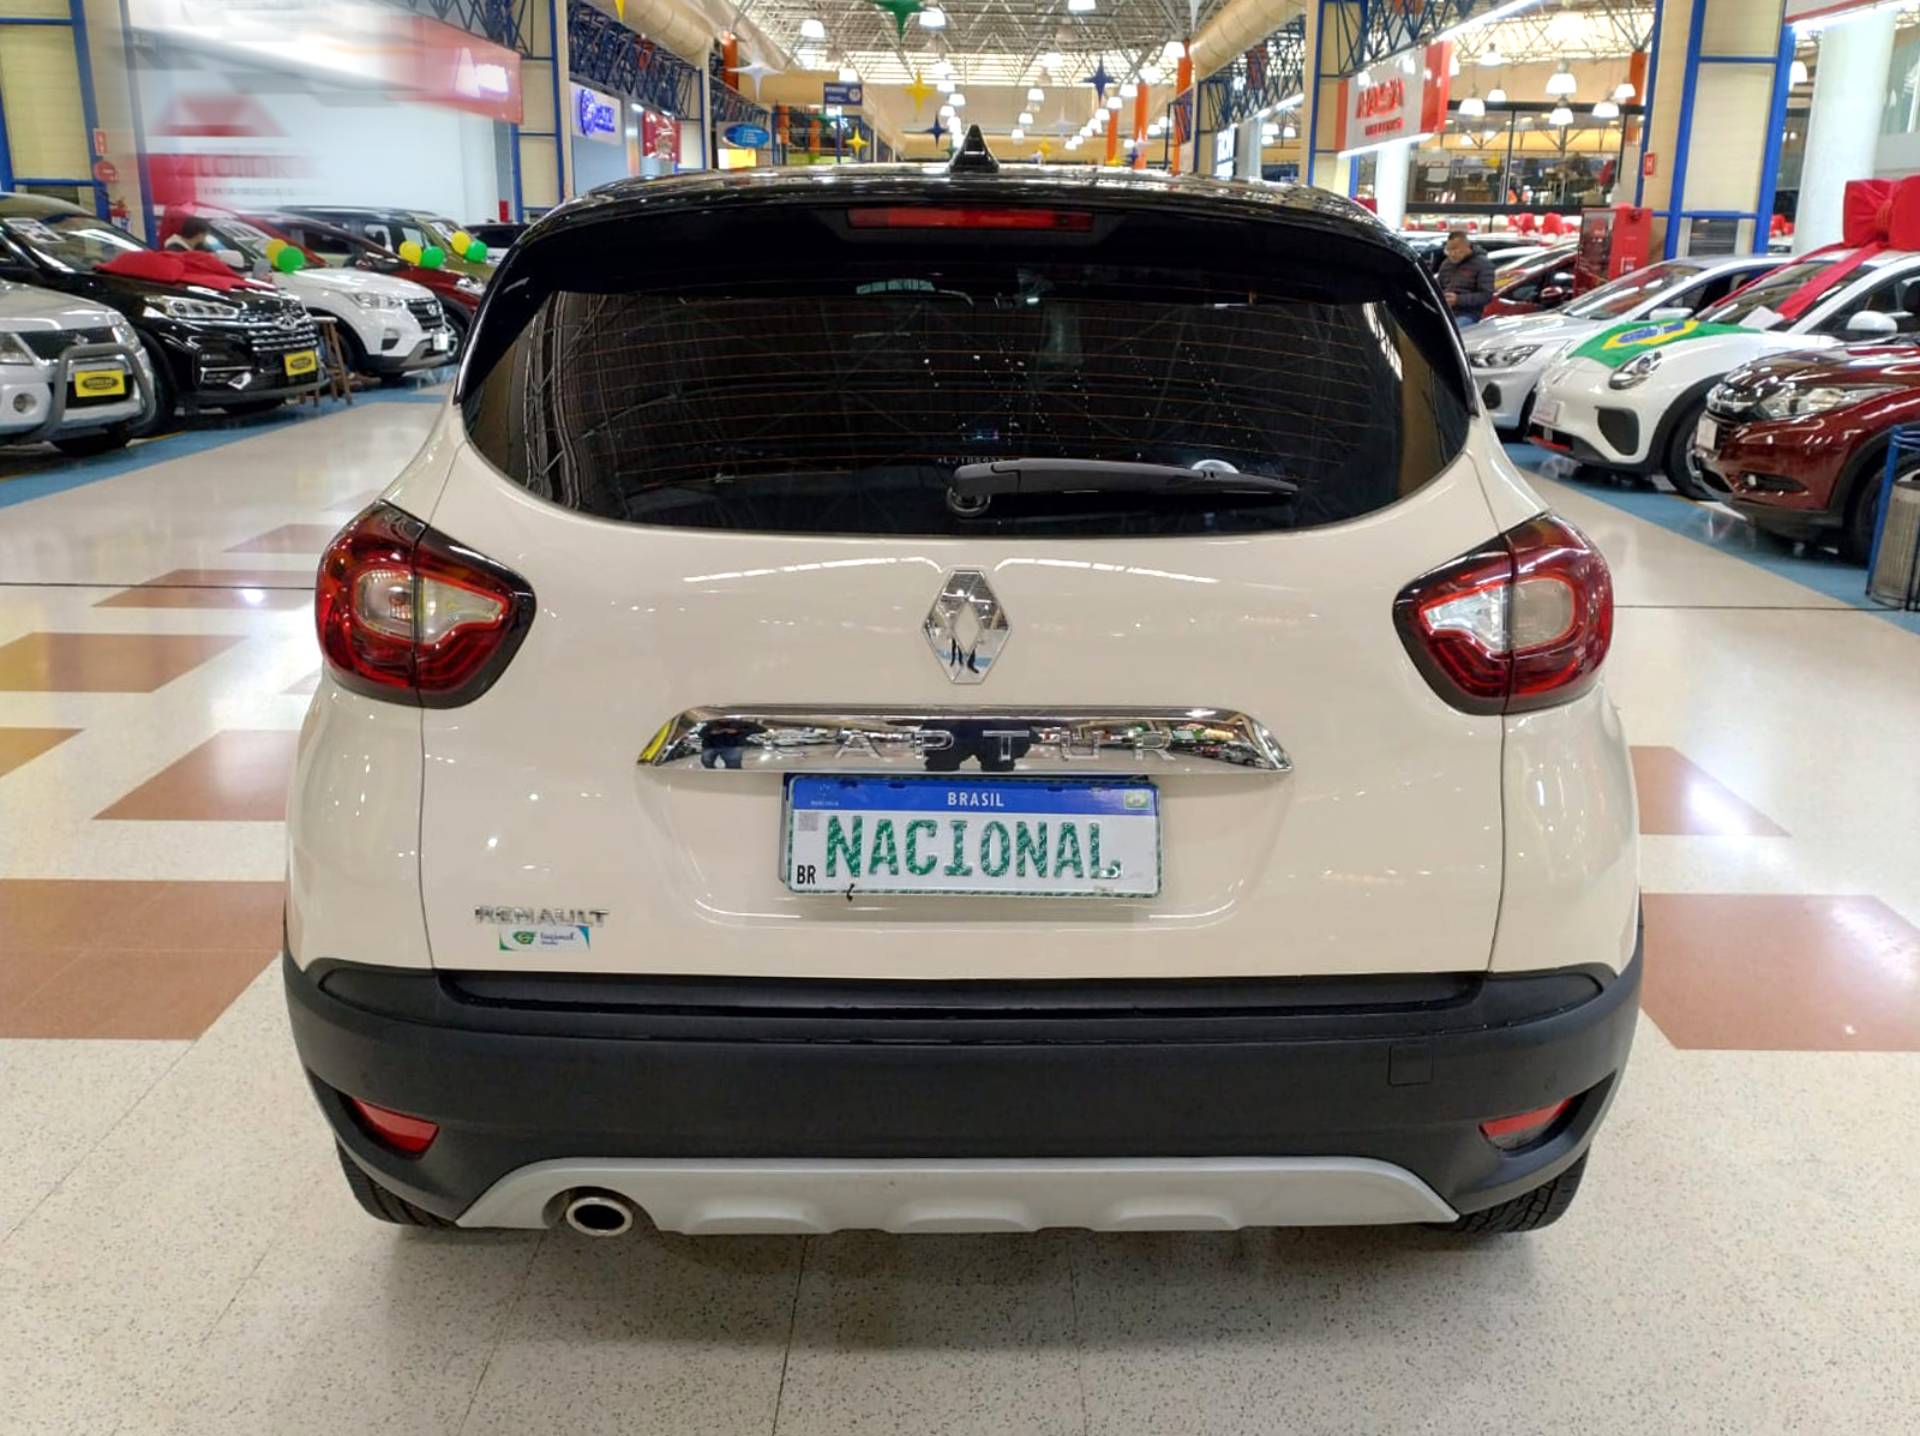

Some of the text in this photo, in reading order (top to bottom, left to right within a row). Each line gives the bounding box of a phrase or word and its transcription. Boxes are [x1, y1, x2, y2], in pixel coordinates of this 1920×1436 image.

[760, 730, 1175, 760] CAPTUR
[949, 793, 1004, 808] BRASIL
[826, 816, 1122, 878] NACIONAL
[796, 865, 816, 884] BR
[475, 906, 608, 926] RENAULT
